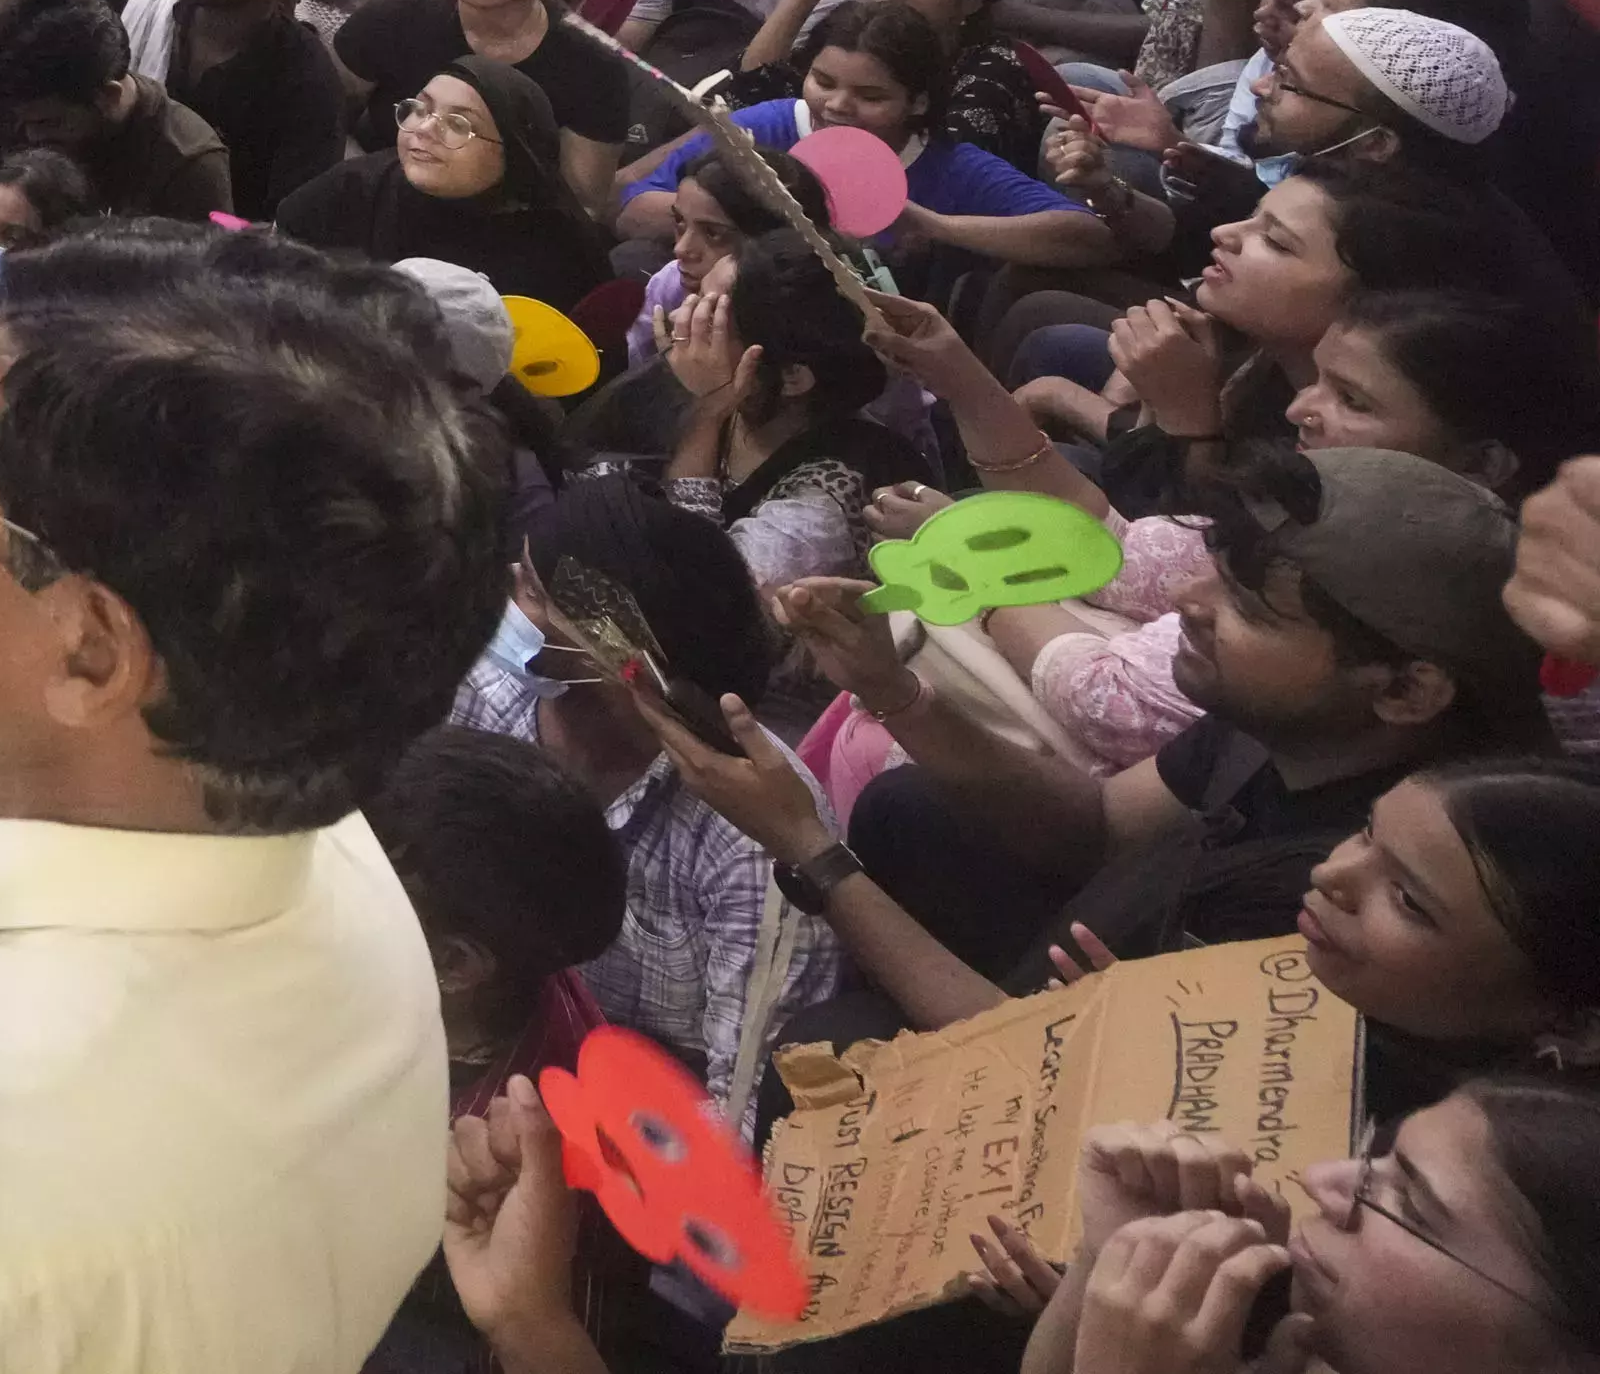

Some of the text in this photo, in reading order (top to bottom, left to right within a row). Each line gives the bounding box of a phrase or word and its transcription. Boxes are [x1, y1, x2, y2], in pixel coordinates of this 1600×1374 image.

[1037, 1013, 1077, 1102] Learn
[1176, 1020, 1239, 1133] PRADHAN
[992, 1094, 1023, 1126] my
[816, 1157, 869, 1258] RESIGN
